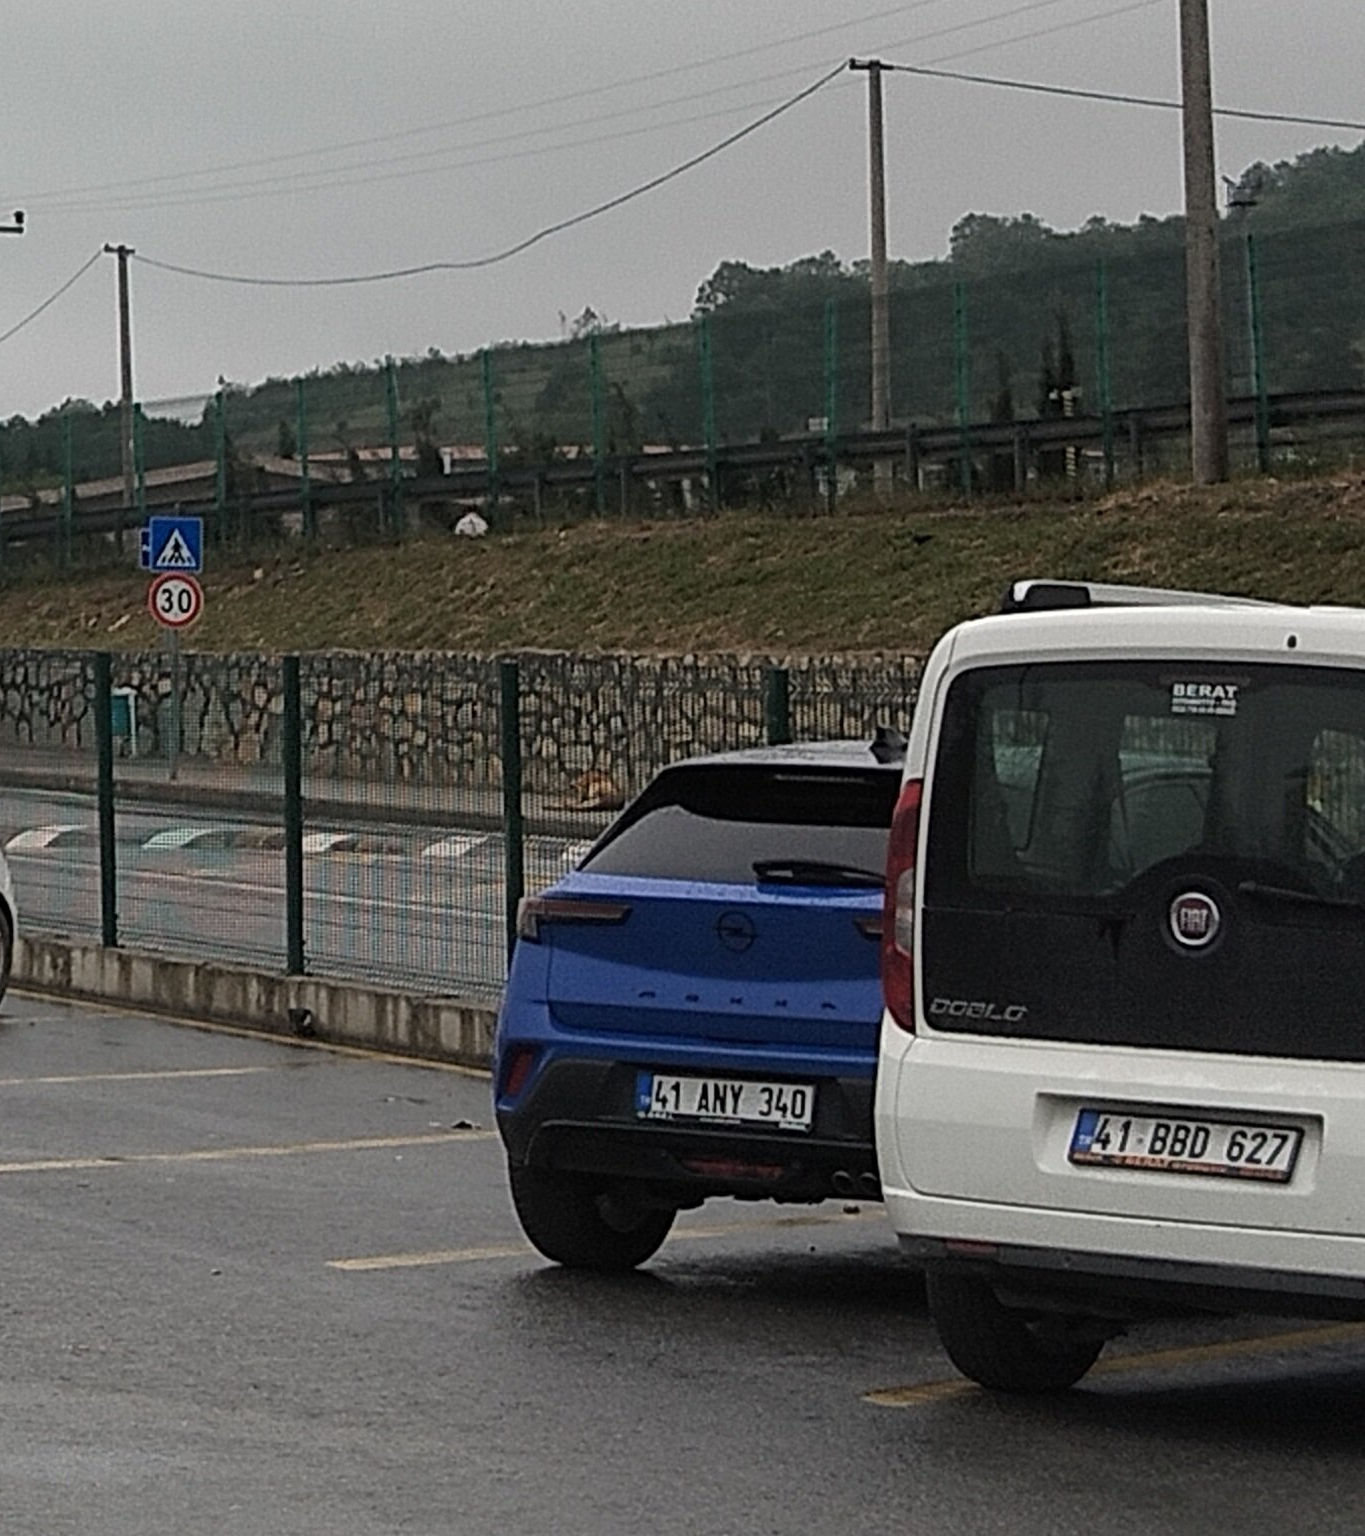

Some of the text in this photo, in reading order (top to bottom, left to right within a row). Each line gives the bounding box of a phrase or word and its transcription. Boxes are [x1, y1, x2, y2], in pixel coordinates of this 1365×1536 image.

[161, 588, 192, 613] 30
[1172, 683, 1238, 699] BERAT
[930, 997, 1029, 1022] DOBLO
[655, 1080, 682, 1111] 41
[697, 1082, 744, 1115] ANY
[758, 1086, 806, 1120] 340
[1094, 1118, 1133, 1152] 41
[1148, 1122, 1211, 1158] BBD
[1225, 1130, 1290, 1166] 627
